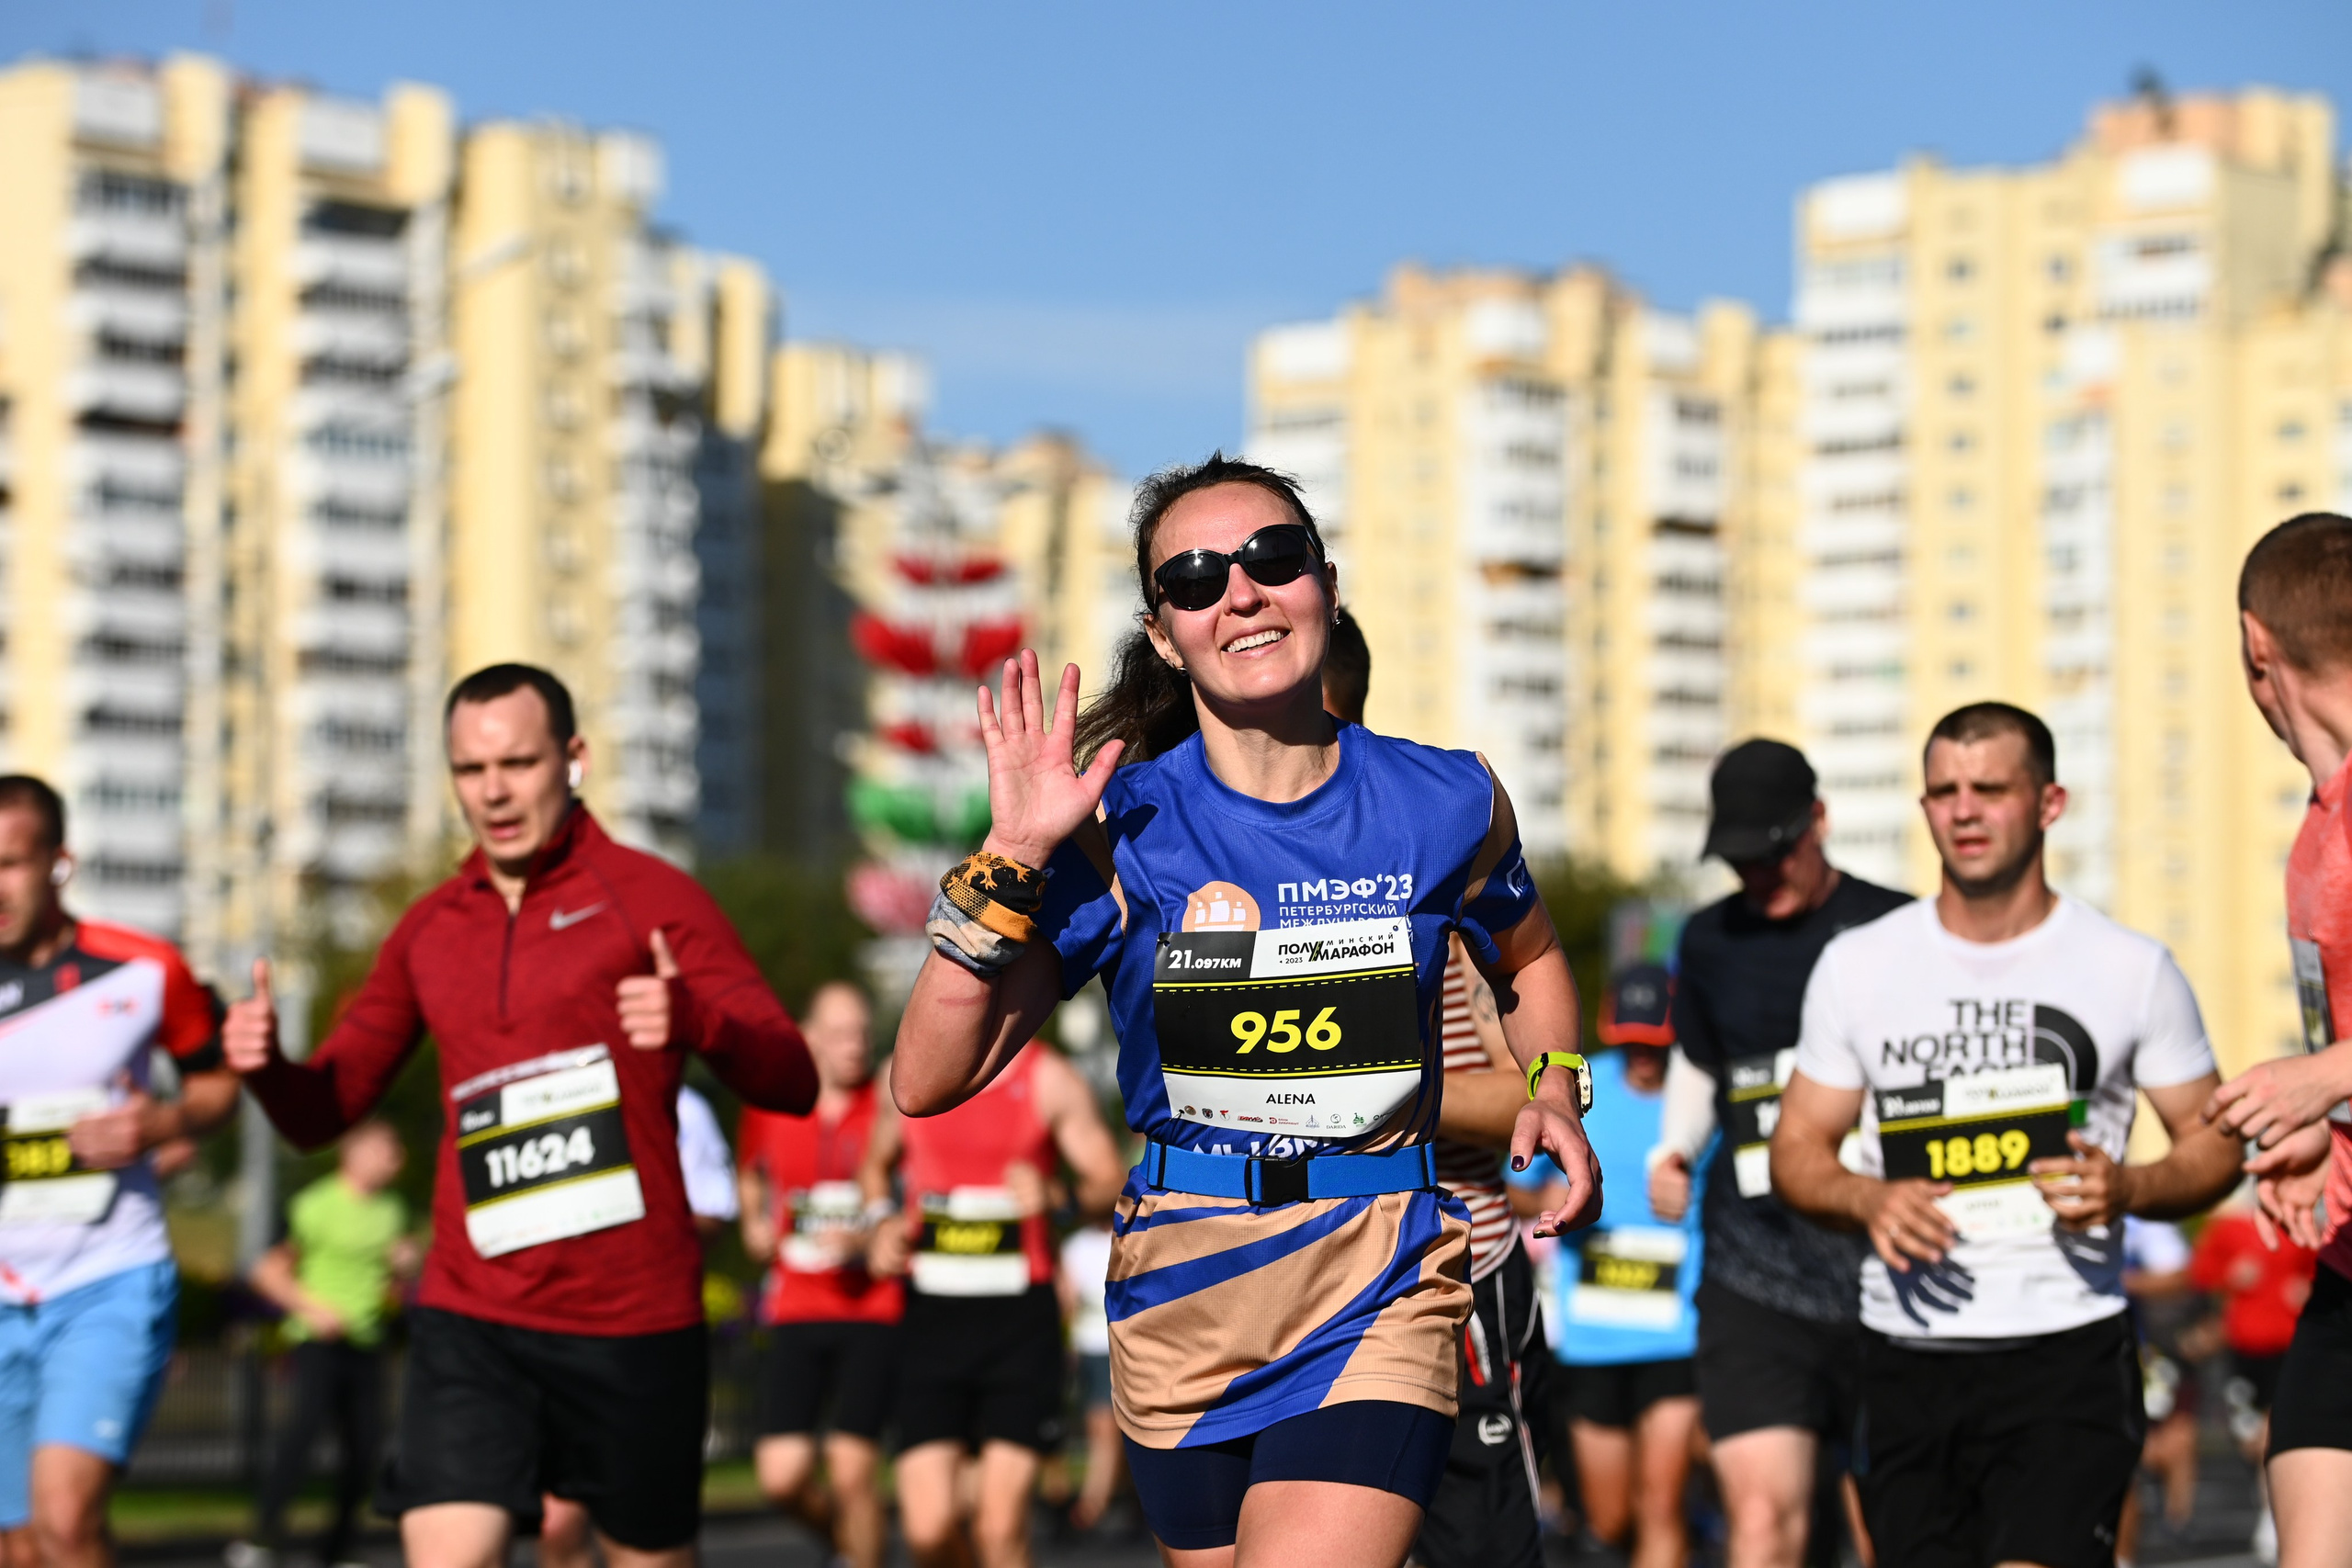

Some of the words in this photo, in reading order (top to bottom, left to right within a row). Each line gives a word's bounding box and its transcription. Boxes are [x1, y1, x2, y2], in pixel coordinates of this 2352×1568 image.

[1279, 903, 1397, 917] ПЕТЕРБУРГСКИЙ
[1326, 932, 1394, 946] МИНСКИЙ
[1168, 950, 1242, 969] 21.097KM
[1950, 999, 2027, 1026] THE
[1230, 1007, 1342, 1055] 956
[1883, 1032, 2027, 1067] NORTH
[1266, 1093, 1316, 1105] ALENA
[485, 1126, 596, 1188] 11624
[1926, 1129, 2030, 1179] 1889
